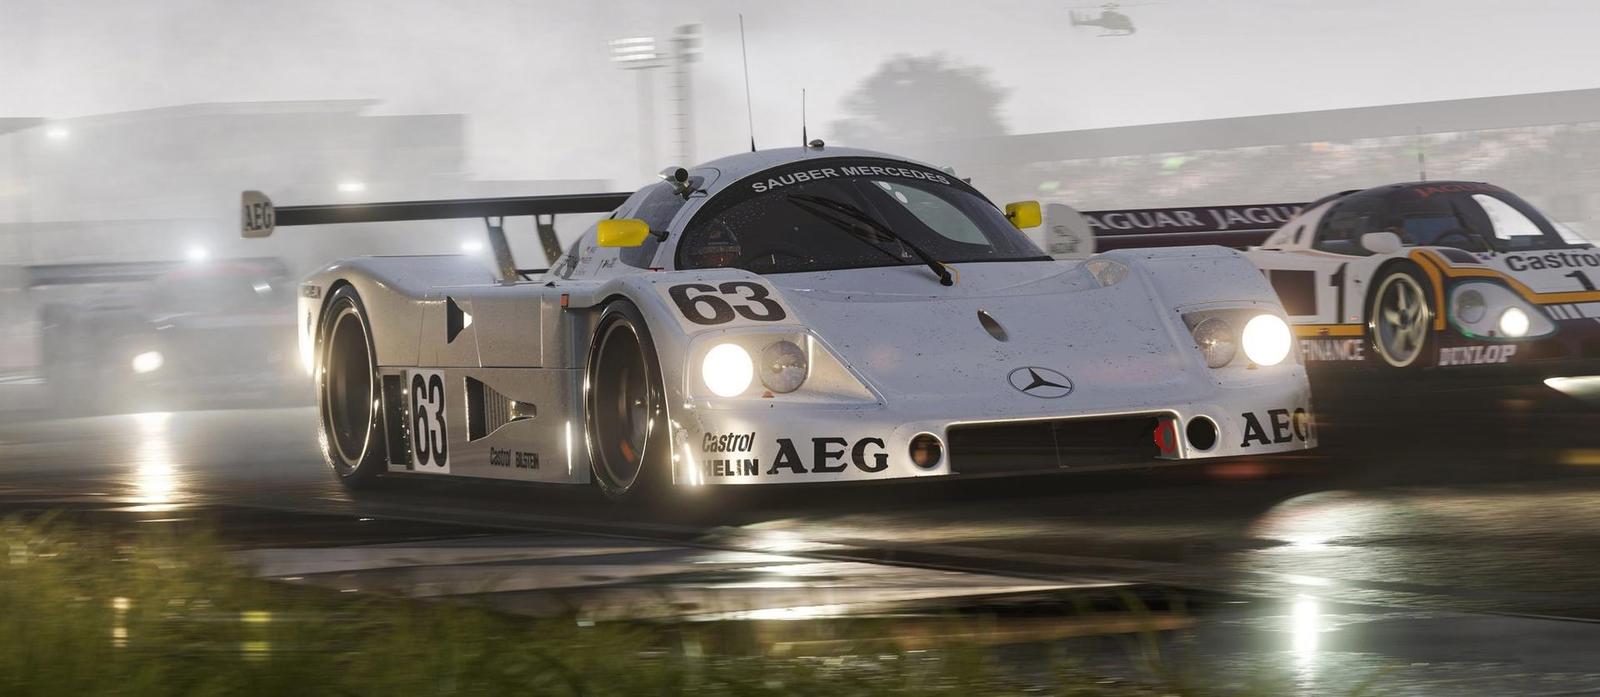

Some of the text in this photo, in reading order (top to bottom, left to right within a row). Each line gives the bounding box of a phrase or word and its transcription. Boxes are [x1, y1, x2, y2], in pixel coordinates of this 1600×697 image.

[752, 166, 950, 193] SAUBER MERCEDES
[245, 202, 272, 231] AEG
[1085, 210, 1205, 230] AGUAR
[1328, 262, 1348, 323] 1
[1564, 270, 1596, 291] 1
[668, 281, 786, 325] 63
[1438, 344, 1518, 366] DUNLOP
[411, 373, 447, 467] 63
[703, 432, 756, 453] Castrol
[490, 446, 511, 467] Castrol
[702, 458, 759, 478] HELIN
[766, 437, 889, 475] AEG
